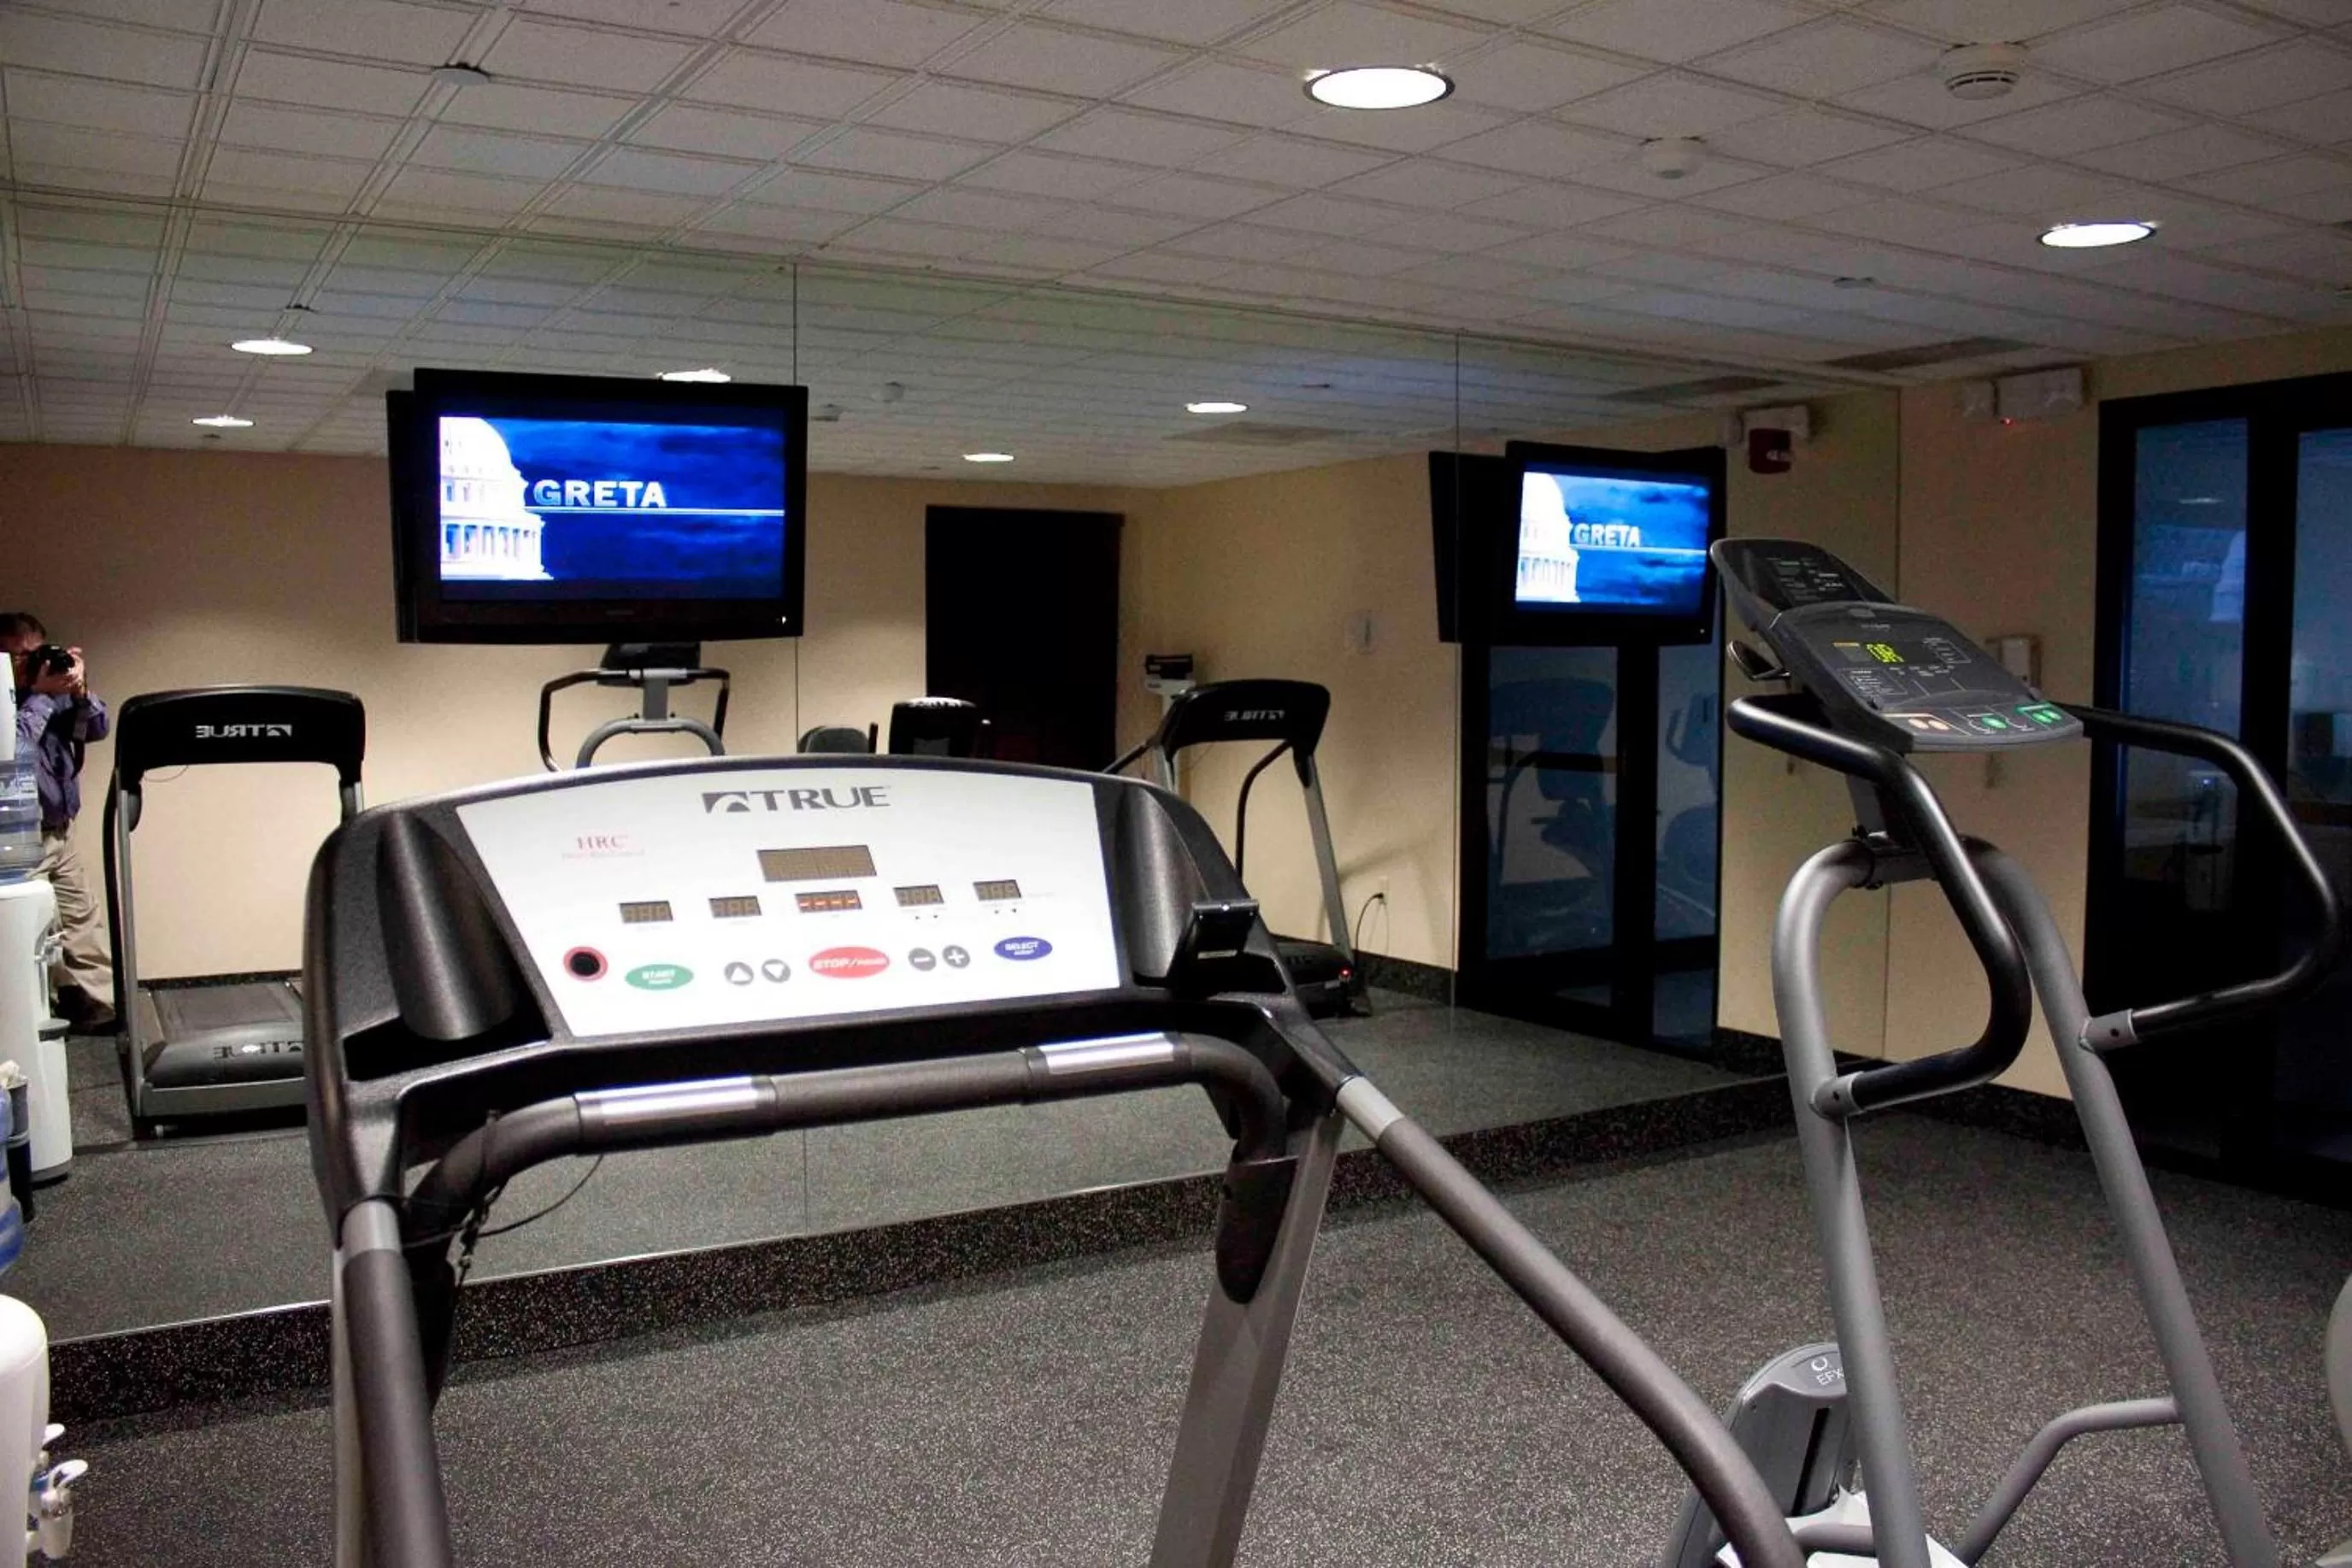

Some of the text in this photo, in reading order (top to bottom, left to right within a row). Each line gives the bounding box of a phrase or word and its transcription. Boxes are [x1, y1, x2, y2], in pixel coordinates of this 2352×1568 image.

[533, 479, 667, 508] GRETA
[1574, 523, 1641, 547] GRETA
[750, 785, 891, 811] TRUE
